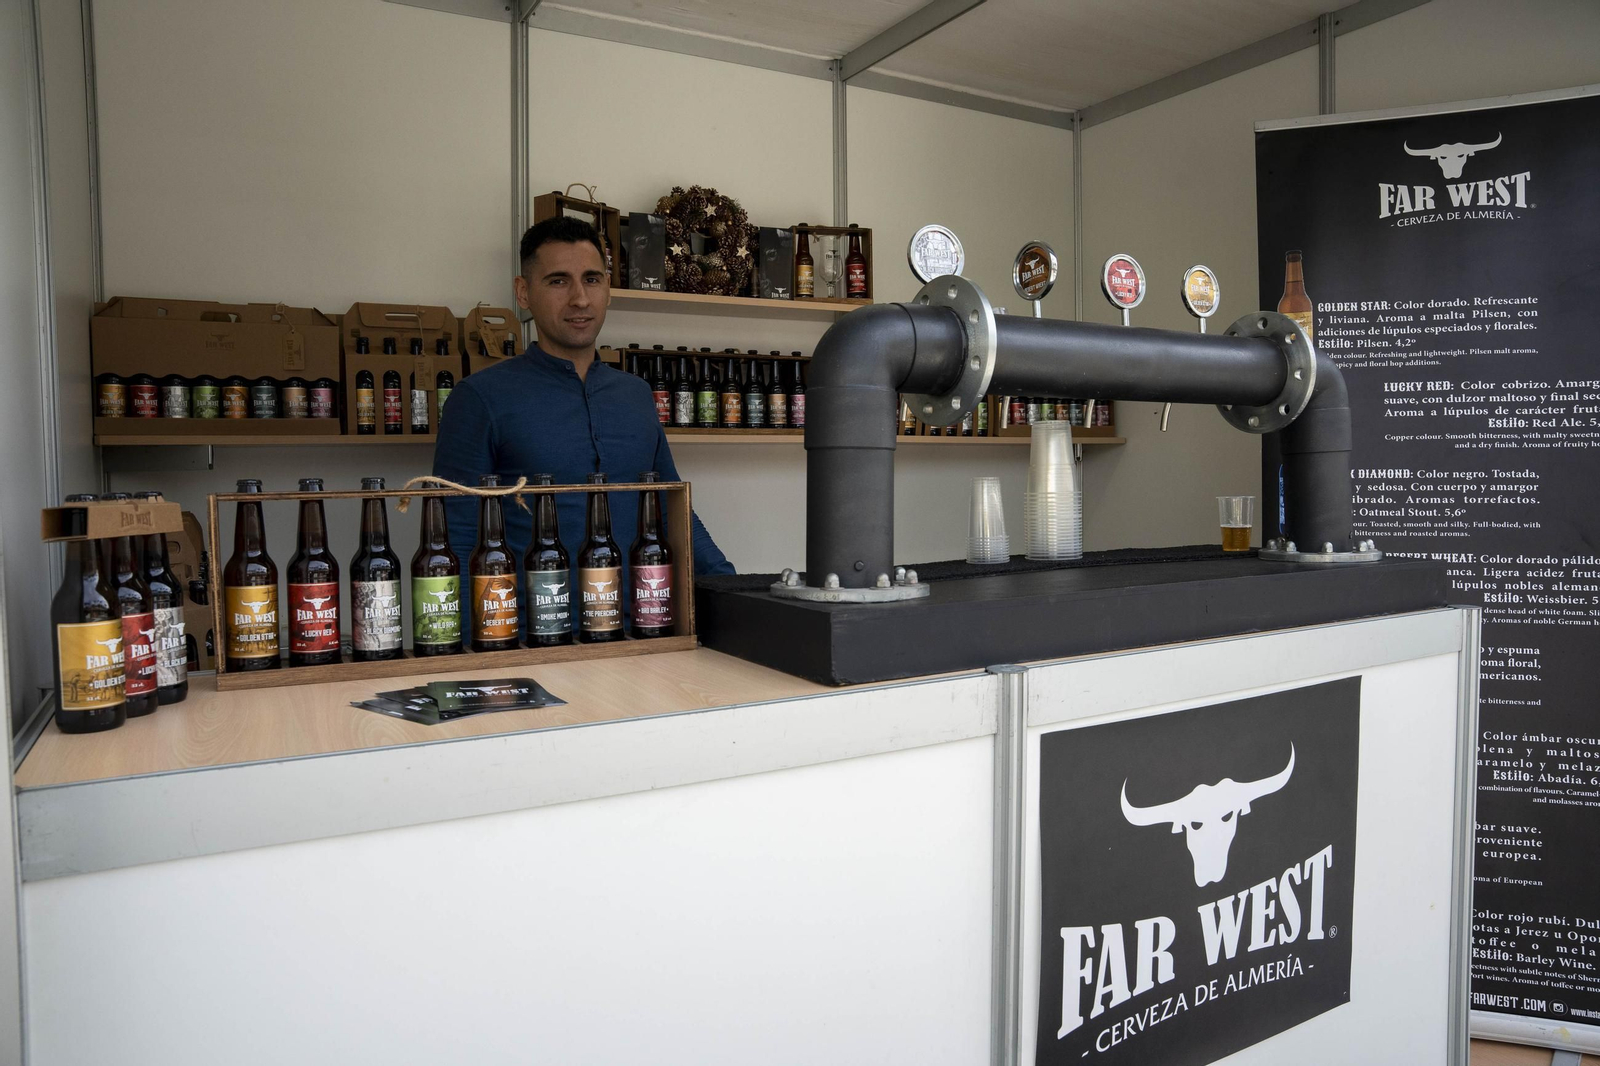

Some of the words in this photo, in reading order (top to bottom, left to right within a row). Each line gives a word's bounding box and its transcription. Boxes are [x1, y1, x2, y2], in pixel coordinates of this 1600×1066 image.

[1379, 182, 1435, 219] FAR
[1446, 171, 1531, 208] WEST
[1397, 214, 1444, 227] CERVEZA
[1447, 212, 1461, 220] DE
[1464, 210, 1514, 220] ALMERÍA
[1022, 271, 1031, 281] FAR
[1032, 265, 1045, 276] WEST
[1112, 275, 1122, 284] FAR
[1122, 278, 1135, 287] WEST
[1318, 302, 1357, 312] GOLDEN
[1361, 301, 1391, 311] STAR:
[1394, 301, 1424, 309] Color
[1427, 298, 1470, 308] dorado.
[1474, 296, 1538, 305] Refrescante
[1318, 318, 1323, 326] y
[1433, 311, 1465, 320] malta
[1473, 309, 1510, 318] Pilsen,
[1318, 328, 1365, 336] adiciones
[1368, 327, 1380, 335] de
[1383, 325, 1422, 336] lúpulos
[1424, 323, 1482, 335] especiados
[1485, 325, 1491, 333] y
[1494, 321, 1537, 330] florales.
[1319, 338, 1353, 348] Estilo:
[1357, 339, 1392, 347] Pilsen.
[1424, 349, 1467, 358] lightweight.
[1384, 382, 1423, 392] LUCKY
[1427, 381, 1454, 391] RED:
[1461, 381, 1495, 389] Color
[1502, 380, 1550, 389] cobrizo.
[1446, 394, 1485, 403] dulzor
[1489, 393, 1536, 402] maltoso
[1540, 395, 1546, 404] y
[1551, 392, 1579, 401] final
[1444, 406, 1488, 418] lúpulos
[1495, 406, 1509, 414] de
[1515, 406, 1566, 414] carácter
[1489, 417, 1528, 428] Estilo:
[1533, 418, 1556, 427] Red
[1561, 418, 1585, 427] Ale.
[1358, 469, 1413, 478] DIAMOND:
[1417, 470, 1449, 478] Color
[1453, 472, 1488, 480] negro.
[1492, 469, 1539, 479] Tostada,
[1356, 485, 1361, 493] y
[1368, 483, 1407, 491] sedosa.
[1411, 483, 1433, 491] Con
[1437, 485, 1477, 493] cuerpo
[1481, 485, 1486, 493] y
[1490, 485, 1538, 493] amargor
[1464, 495, 1540, 504] torrefactos.
[1359, 508, 1404, 516] Oatmeal
[1408, 508, 1440, 516] Stout.
[121, 512, 134, 528] FAR
[1480, 555, 1513, 563] Color
[1516, 555, 1558, 564] dorado
[1484, 568, 1519, 579] Ligera
[1527, 568, 1564, 577] acidez
[1452, 580, 1497, 591] lúpulos
[1505, 581, 1543, 590] nobles
[536, 594, 552, 606] FAR
[553, 592, 569, 603] WEST
[583, 591, 597, 602] FAR
[599, 590, 618, 601] WEST
[636, 588, 650, 599] FAR
[652, 587, 670, 598] WEST
[1484, 592, 1523, 603] Estilo:
[1527, 595, 1587, 604] Weissbier.
[423, 602, 439, 613] FAR
[440, 600, 459, 611] WEST
[484, 599, 499, 611] FAR
[502, 597, 517, 608] WEST
[235, 613, 251, 625] FAR
[255, 611, 276, 623] WEST
[297, 609, 313, 621] FAR
[316, 607, 337, 619] WEST
[365, 607, 383, 619] FAR
[384, 605, 401, 616] WEST
[304, 629, 322, 638] LUCKY
[162, 637, 179, 650] FAR
[131, 644, 149, 658] FAR
[1488, 647, 1494, 656] y
[1497, 648, 1540, 656] espuma
[86, 655, 108, 670] FAR
[1508, 658, 1541, 669] floral,
[1483, 731, 1517, 741] Color
[1522, 733, 1561, 743] ámbar
[1493, 770, 1533, 781] Estilo:
[1538, 773, 1586, 784] Abadía.
[1501, 826, 1541, 834] suave.
[1483, 851, 1541, 861] europea.
[1508, 913, 1533, 924] rojo
[1539, 916, 1570, 926] rubí.
[1516, 926, 1548, 937] Jerez
[1057, 916, 1176, 1040] FAR
[1197, 844, 1333, 966] WEST
[1473, 948, 1512, 961] Estilo:
[1517, 953, 1555, 967] Barley
[1559, 958, 1596, 970] Wine.
[1095, 992, 1188, 1054] CERVEZA
[1194, 983, 1219, 1006] DE
[1224, 954, 1304, 996] ALMERÍA
